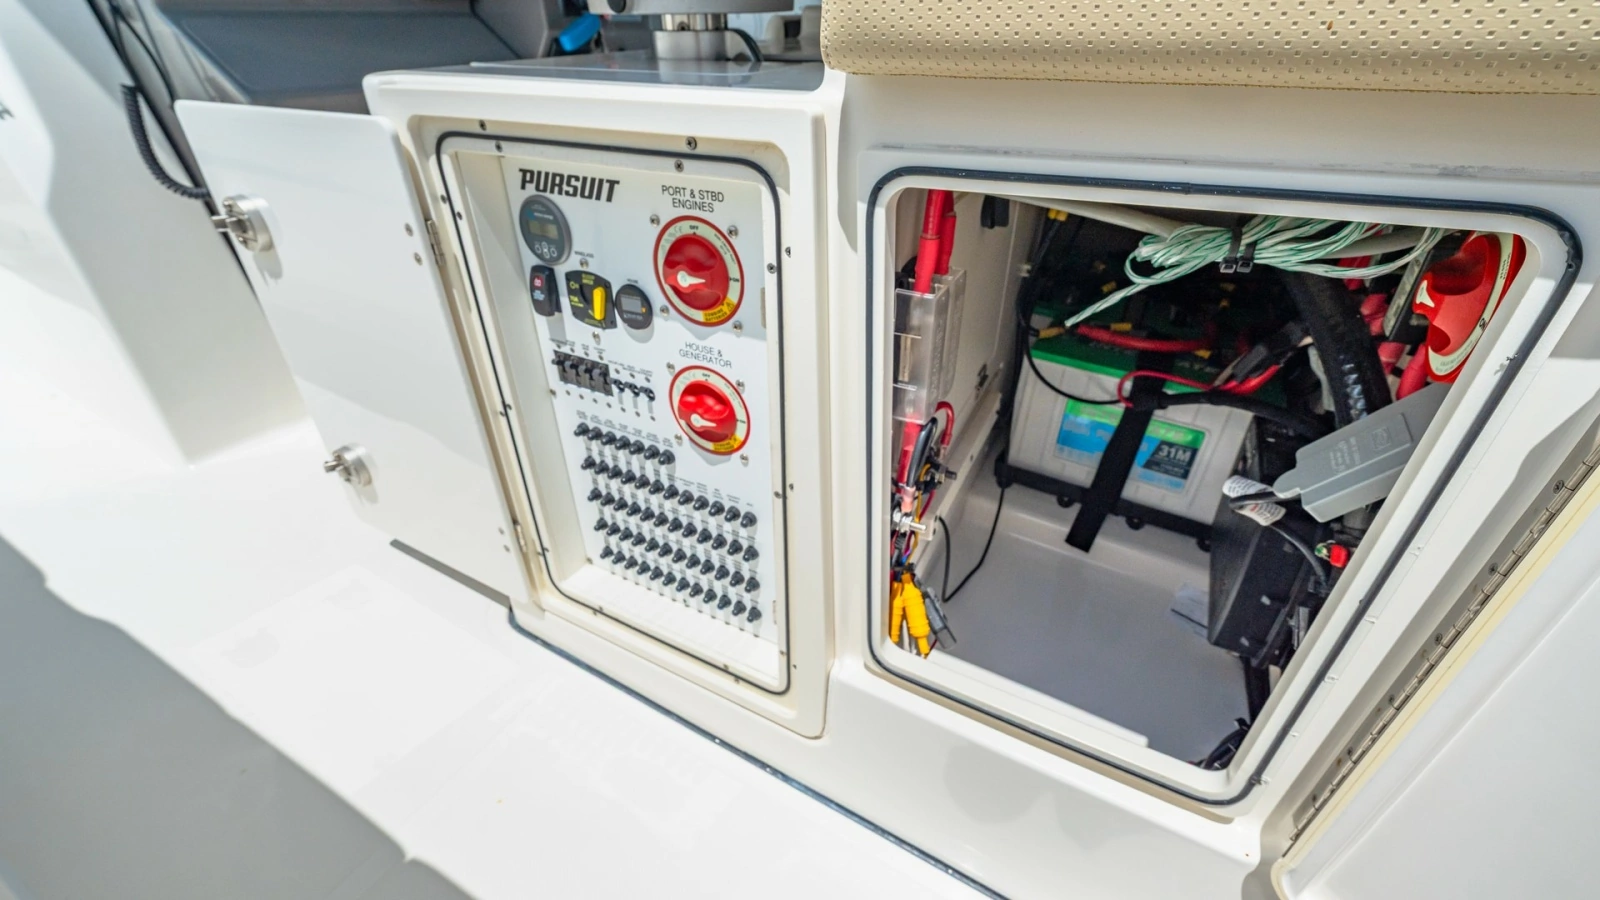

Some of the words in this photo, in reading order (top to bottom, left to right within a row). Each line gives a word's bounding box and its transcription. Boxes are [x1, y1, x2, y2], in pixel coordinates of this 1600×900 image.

[518, 168, 620, 203] PURSUIT
[661, 185, 687, 197] PORT
[689, 189, 696, 199] &
[698, 189, 724, 202] STBD
[672, 197, 715, 213] ENGINES
[679, 349, 732, 368] GENERATOR
[685, 342, 715, 355] HOUSE
[717, 349, 723, 358] &
[1158, 444, 1192, 462] 31M
